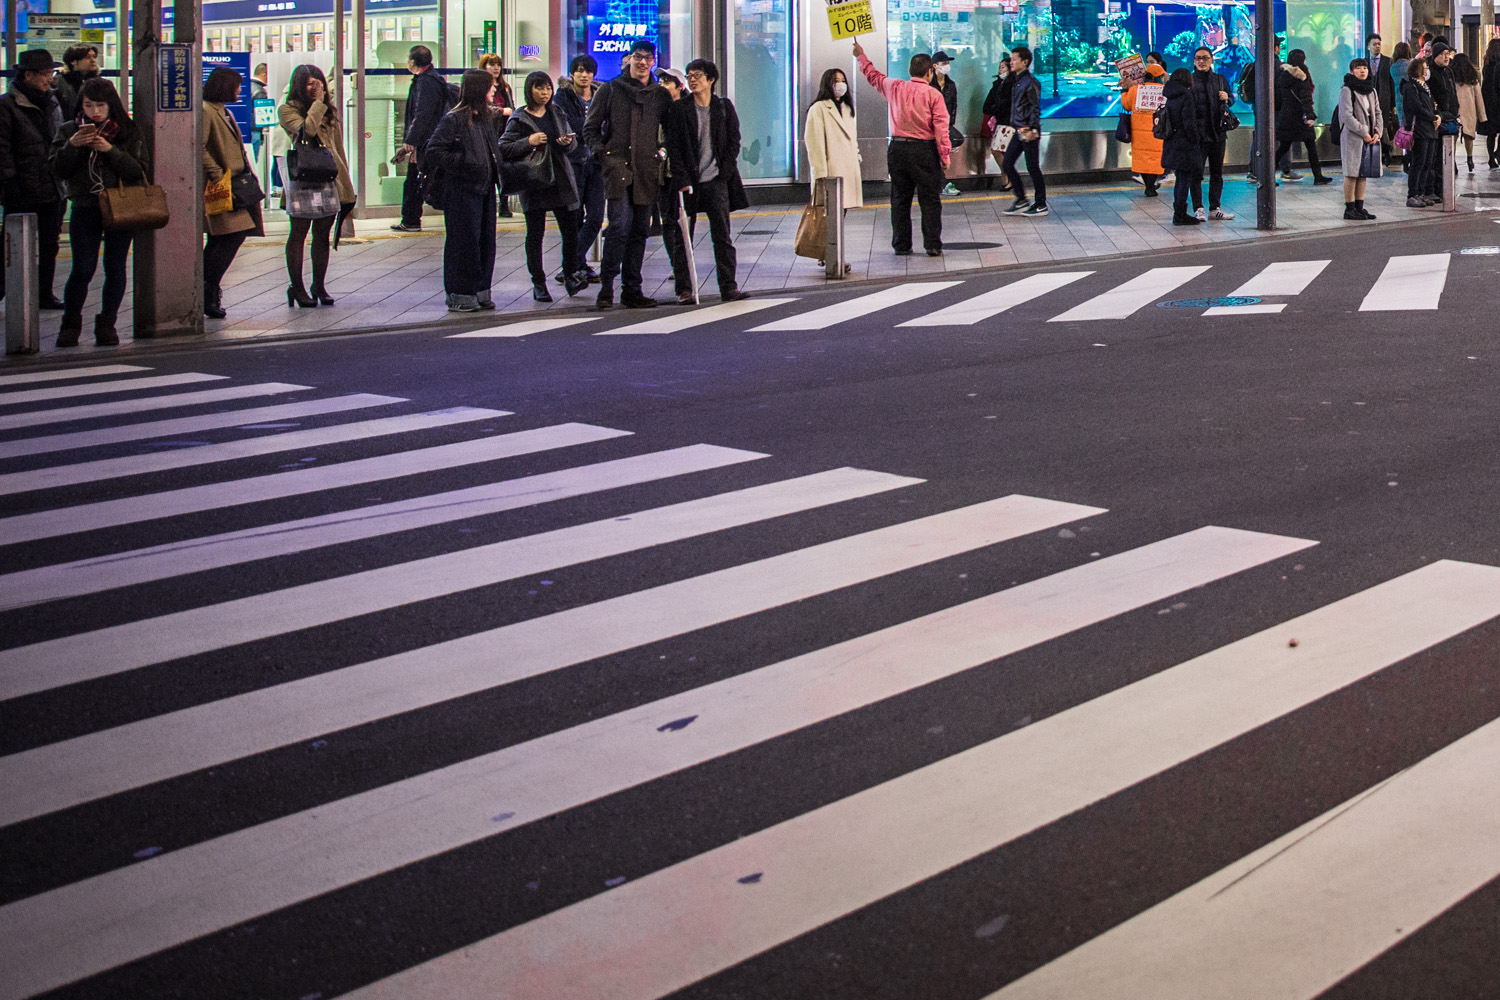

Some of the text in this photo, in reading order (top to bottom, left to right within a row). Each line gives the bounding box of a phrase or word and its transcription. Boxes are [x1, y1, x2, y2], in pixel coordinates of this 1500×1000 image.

[598, 23, 648, 36] 外貨両替
[832, 12, 872, 36] 10階
[174, 49, 187, 109] 防犯カメラ作動中
